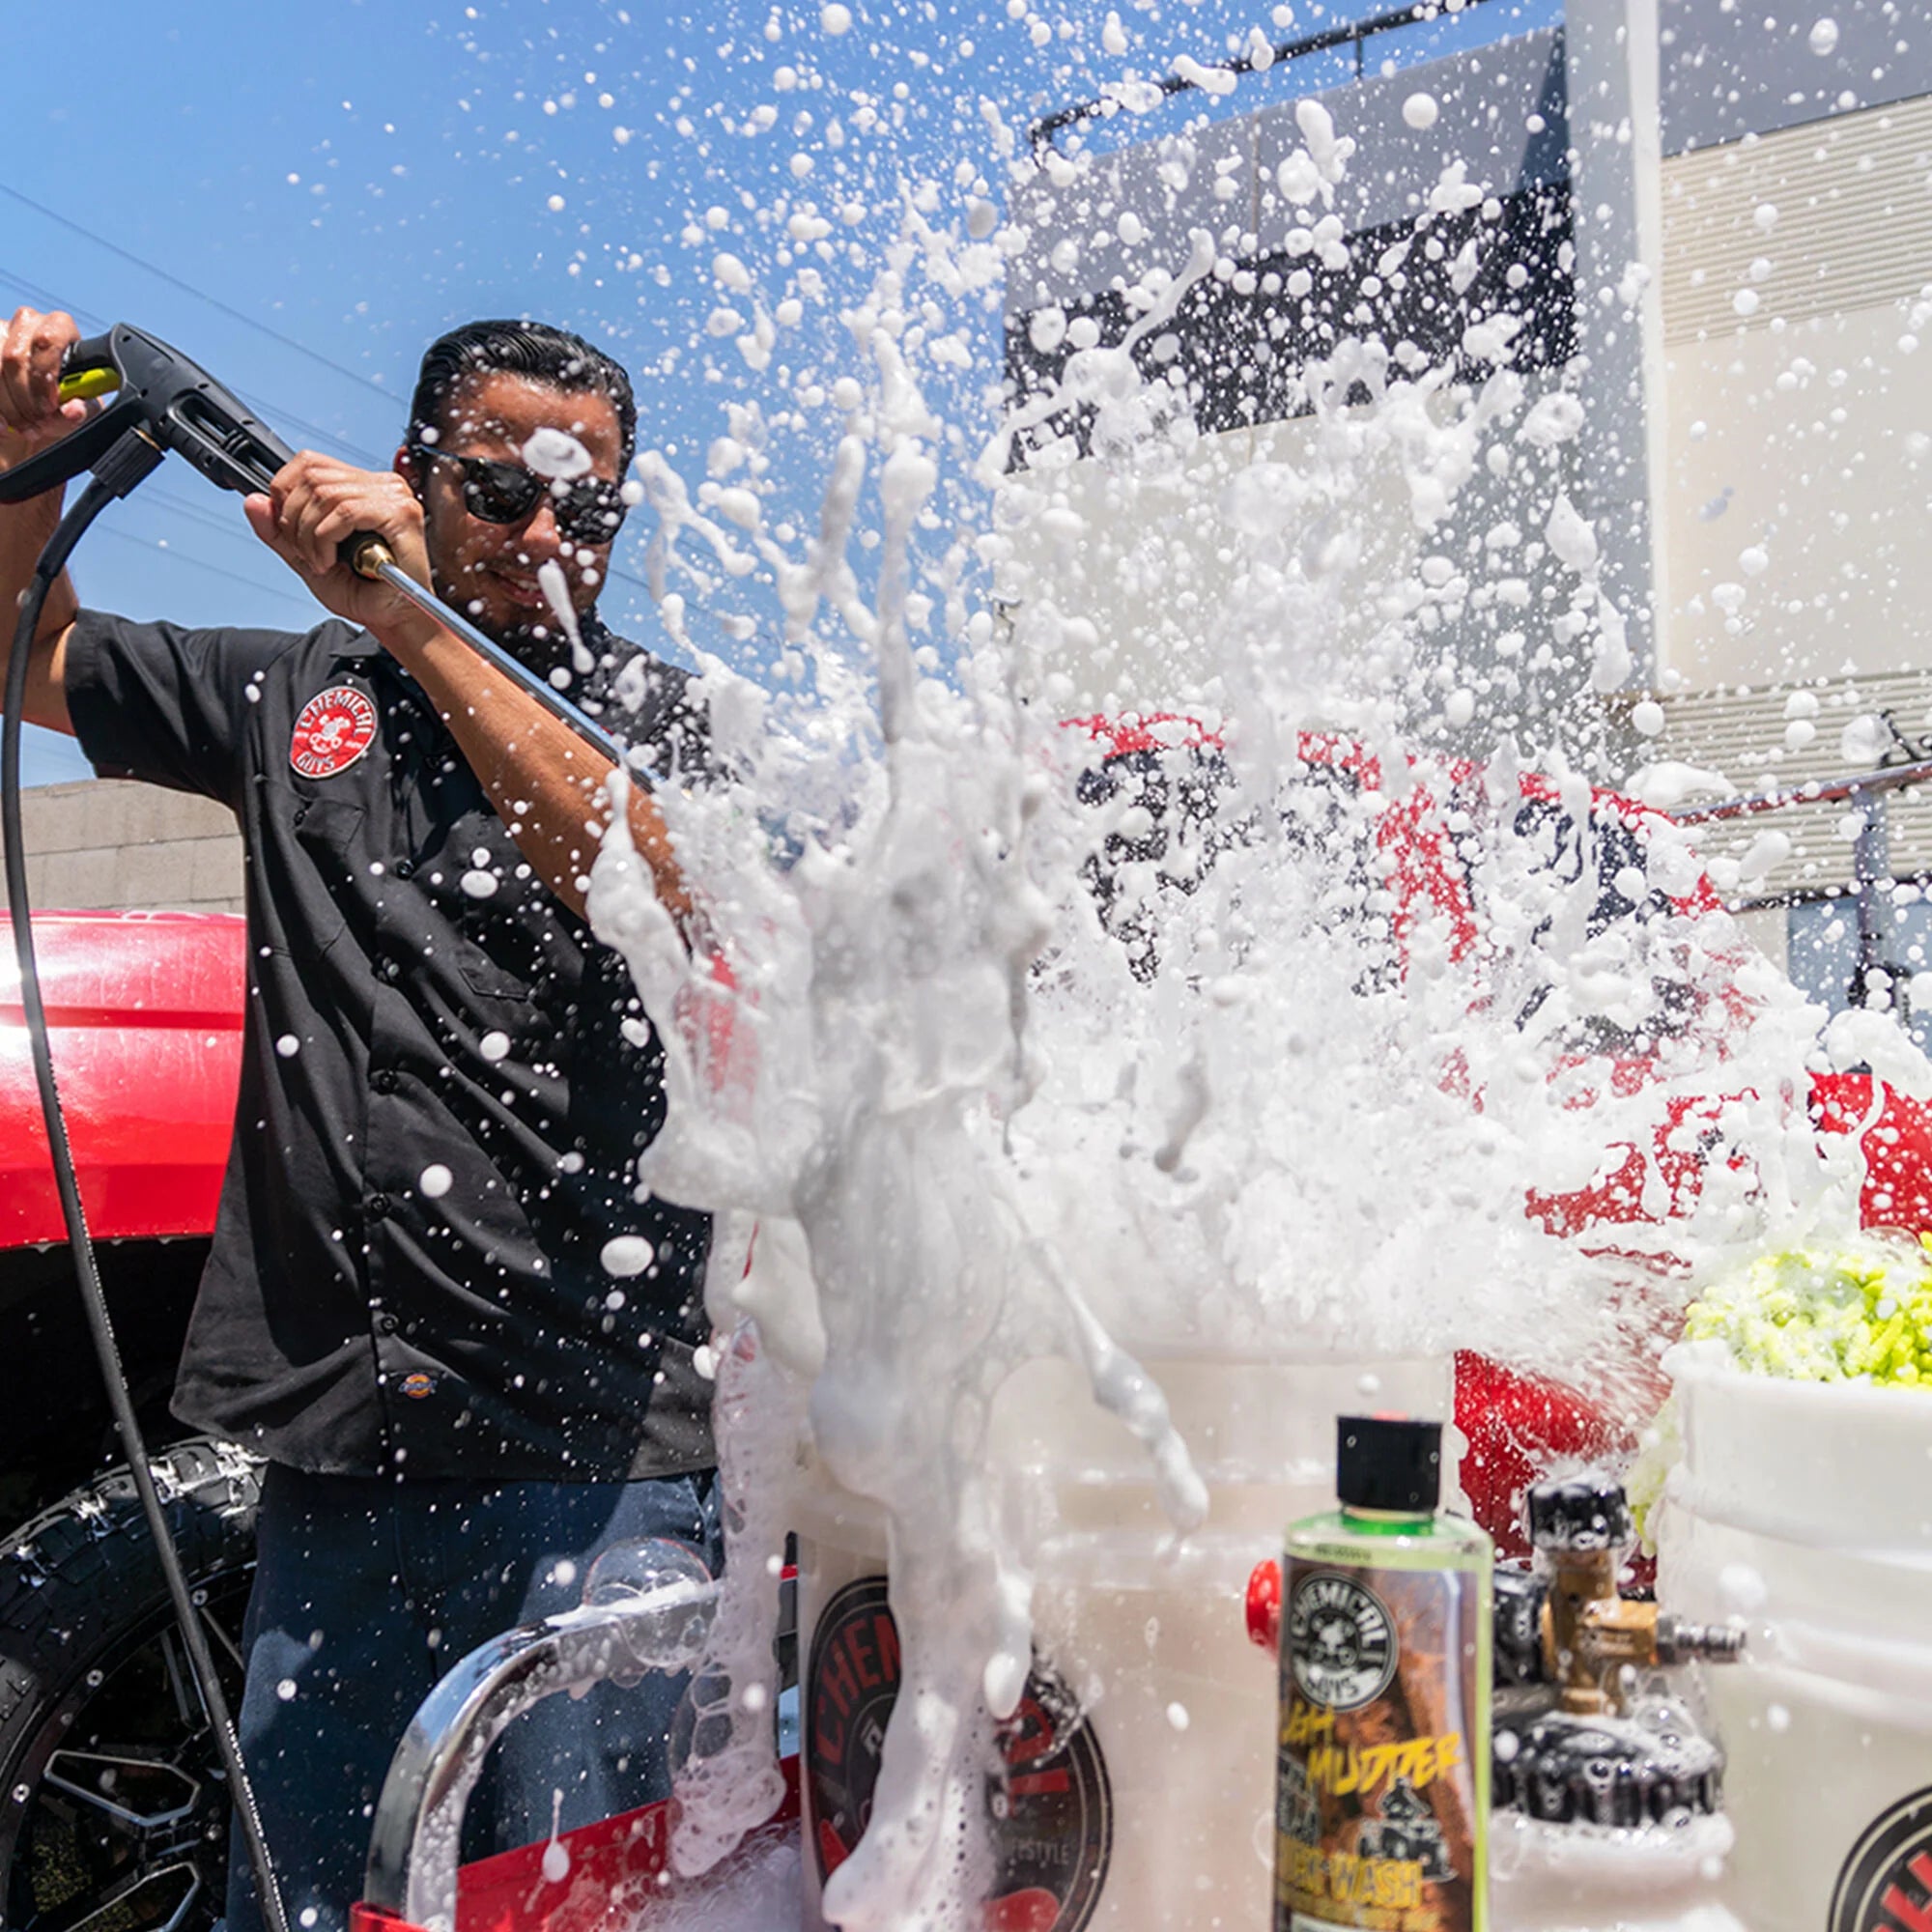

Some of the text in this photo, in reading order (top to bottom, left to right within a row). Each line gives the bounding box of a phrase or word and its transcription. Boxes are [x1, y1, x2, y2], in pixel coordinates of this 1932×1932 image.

[299, 690, 372, 737] CHEMICAL
[297, 752, 334, 774] GUYS
[1290, 1582, 1388, 1649] CHEMICAL
[1328, 1850, 1423, 1909] WASH
